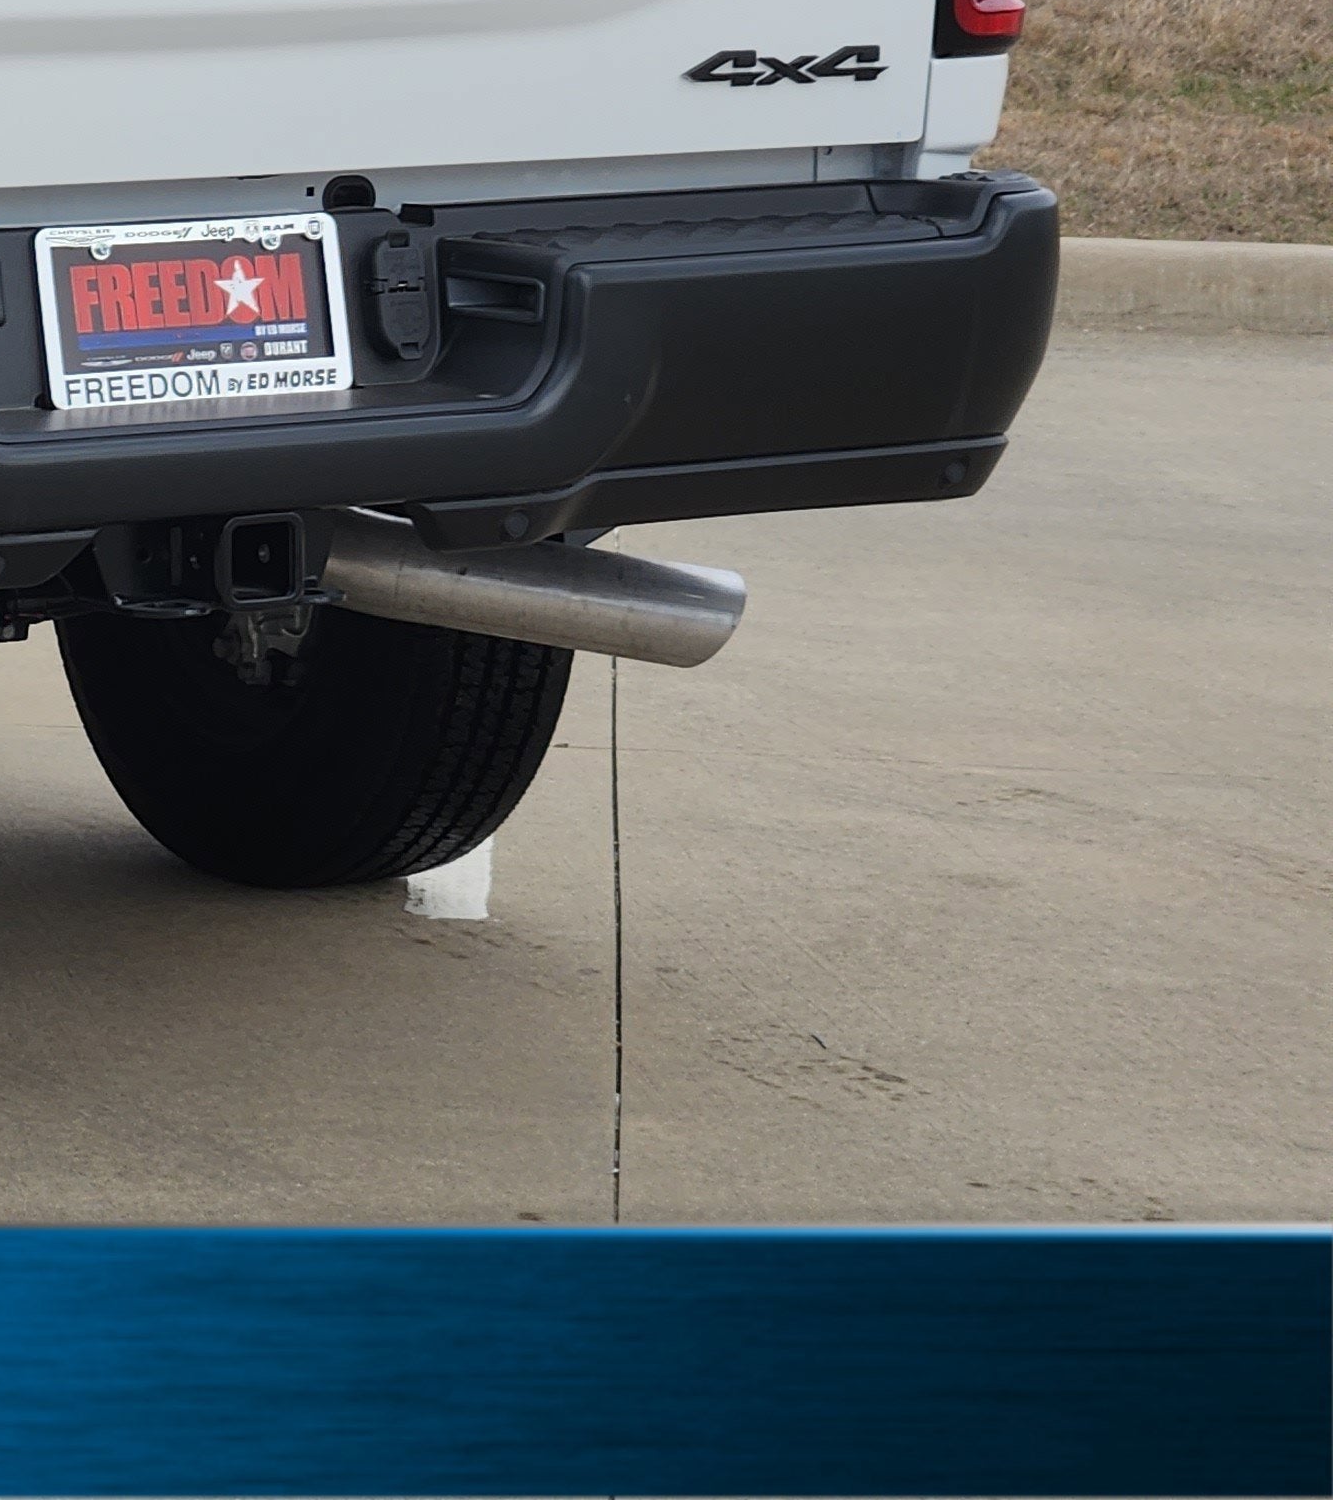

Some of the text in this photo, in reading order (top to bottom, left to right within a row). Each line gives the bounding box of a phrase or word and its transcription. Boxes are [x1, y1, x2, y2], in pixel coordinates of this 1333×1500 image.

[680, 44, 890, 87] 4x4
[124, 228, 183, 238] DODGE
[201, 224, 235, 238] Jeep
[262, 223, 295, 231] RAM
[70, 253, 307, 334] FREEDOM
[186, 348, 217, 361] Jeep
[263, 340, 308, 356] DURANT
[64, 369, 221, 407] FREEDOM
[247, 372, 269, 390] ED
[274, 368, 337, 389] MORSE
